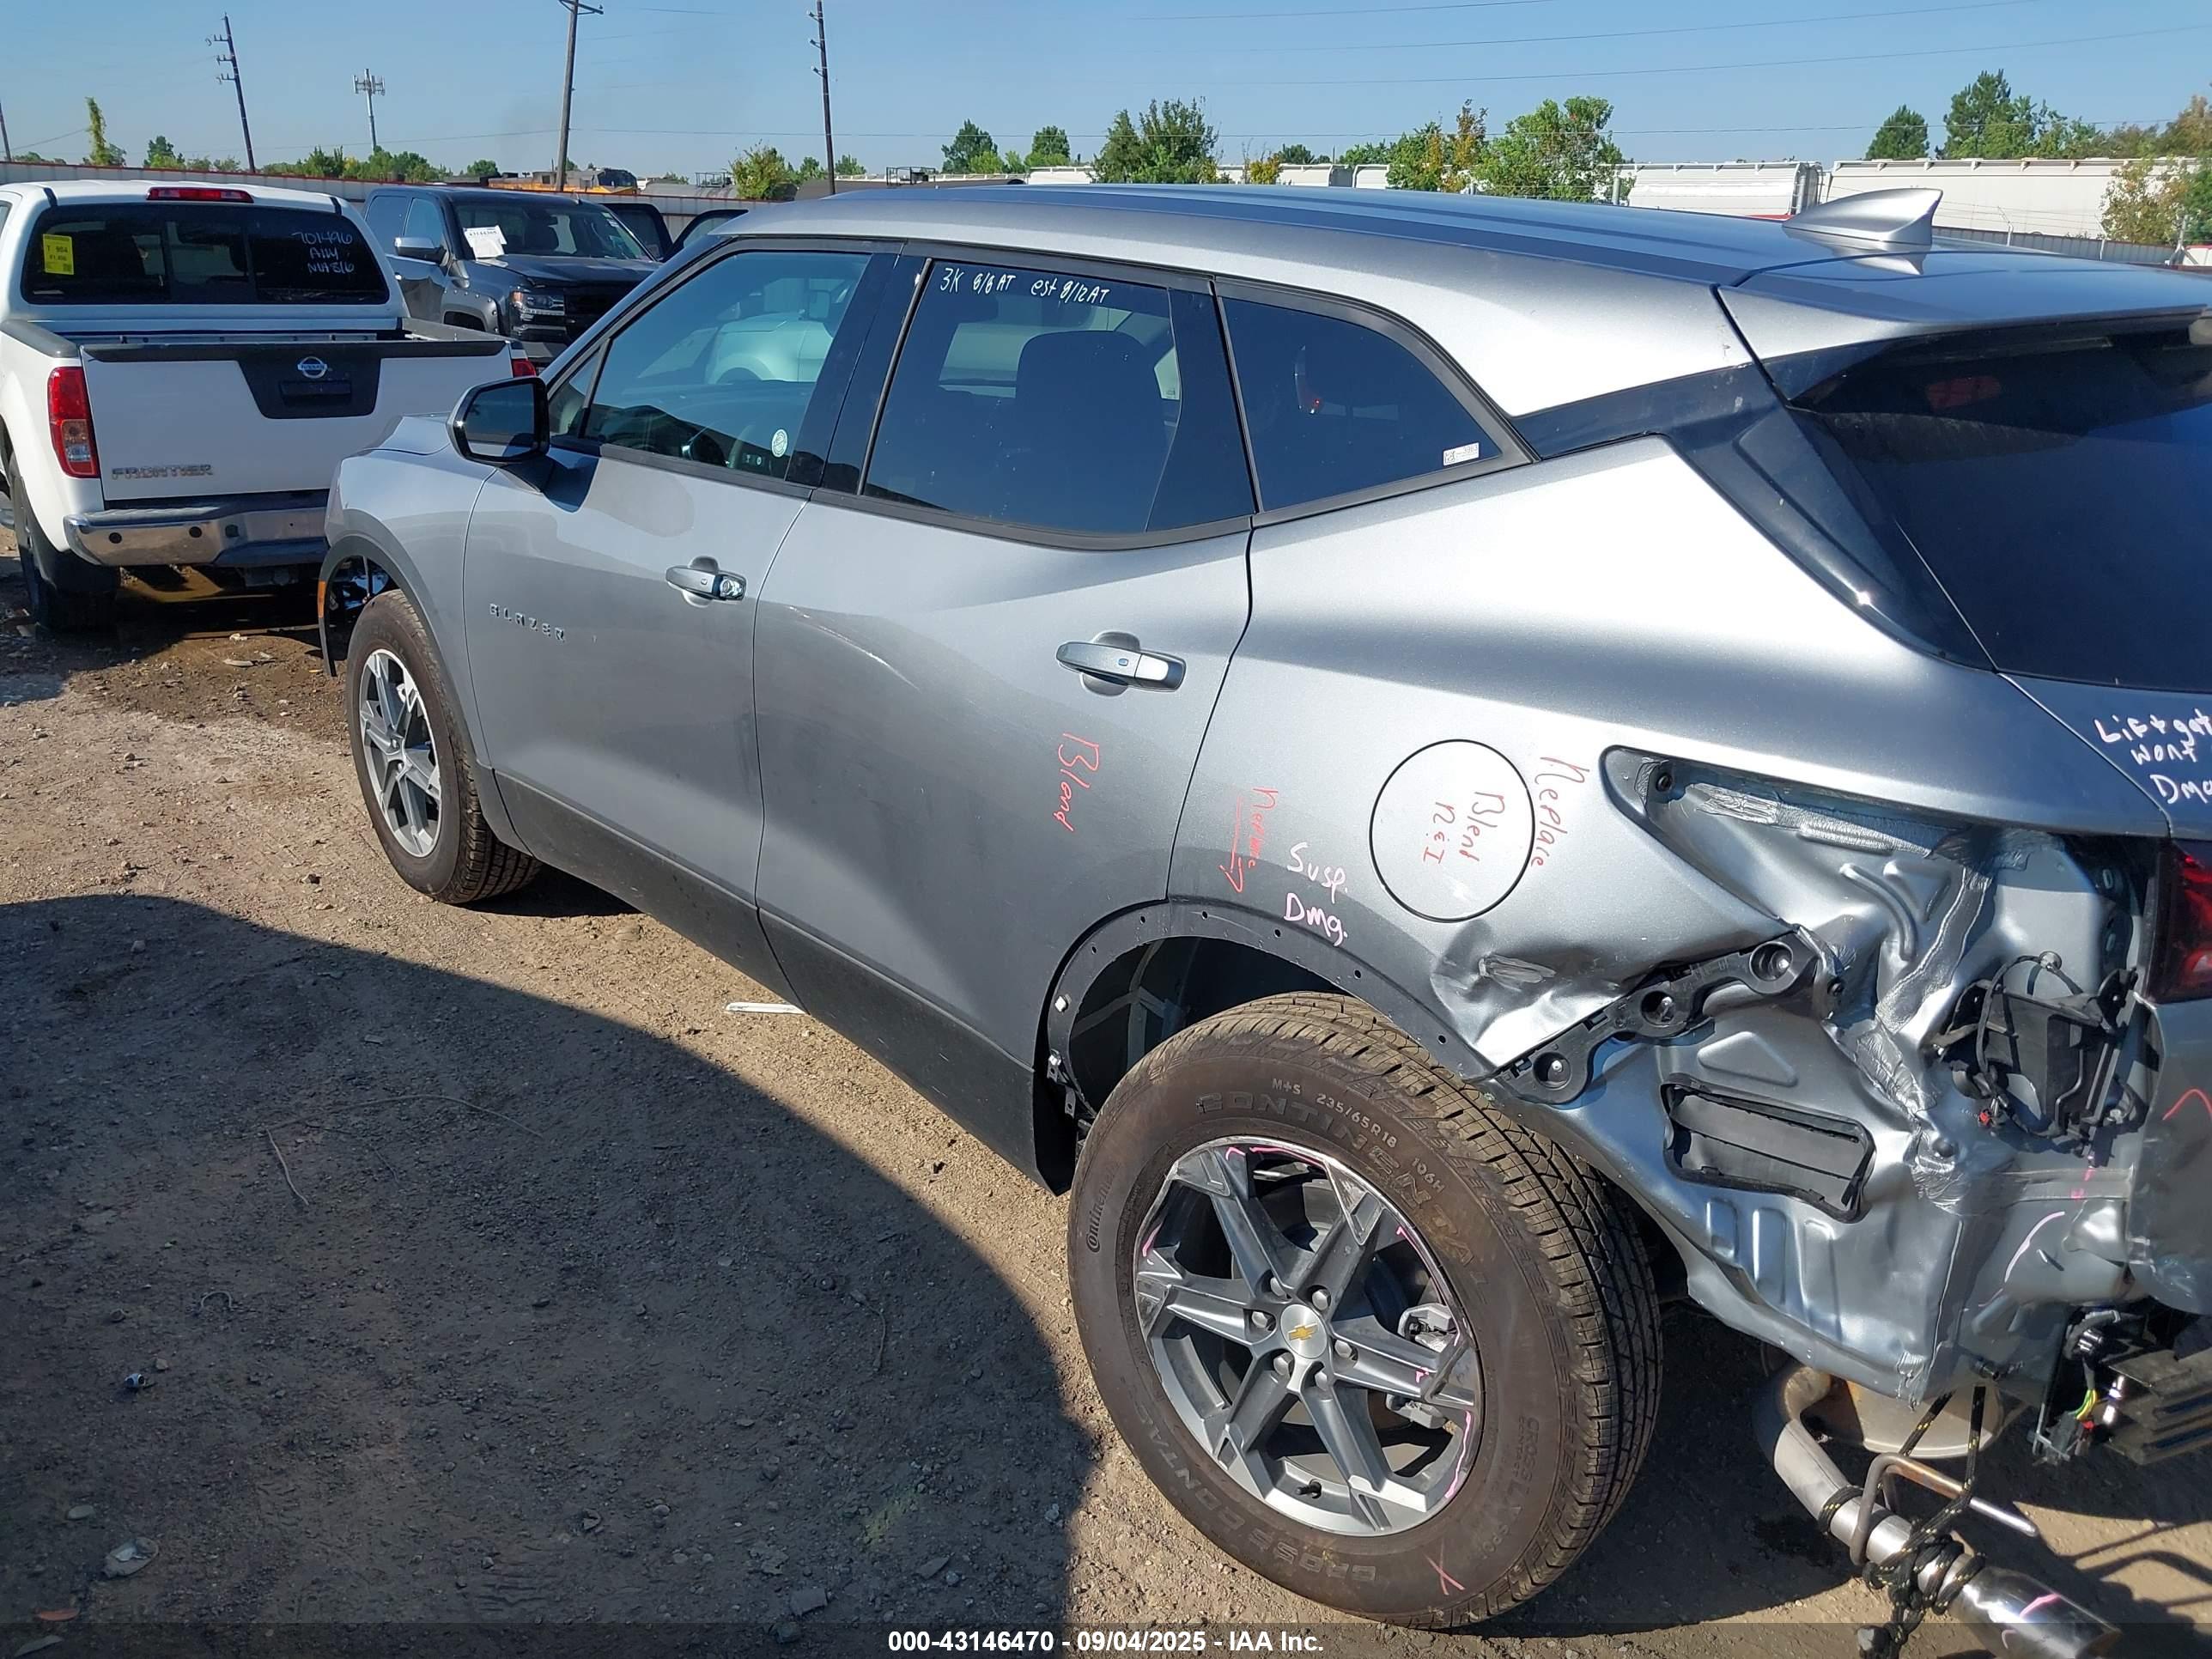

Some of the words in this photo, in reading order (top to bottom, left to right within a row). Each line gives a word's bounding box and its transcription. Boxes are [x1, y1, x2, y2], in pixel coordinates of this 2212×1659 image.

[1030, 277, 1057, 297] est
[112, 464, 214, 480] FRONTIER
[489, 603, 566, 643] BLAZER
[1283, 892, 1348, 946] Dmg.
[1272, 1078, 1301, 1095] M+S
